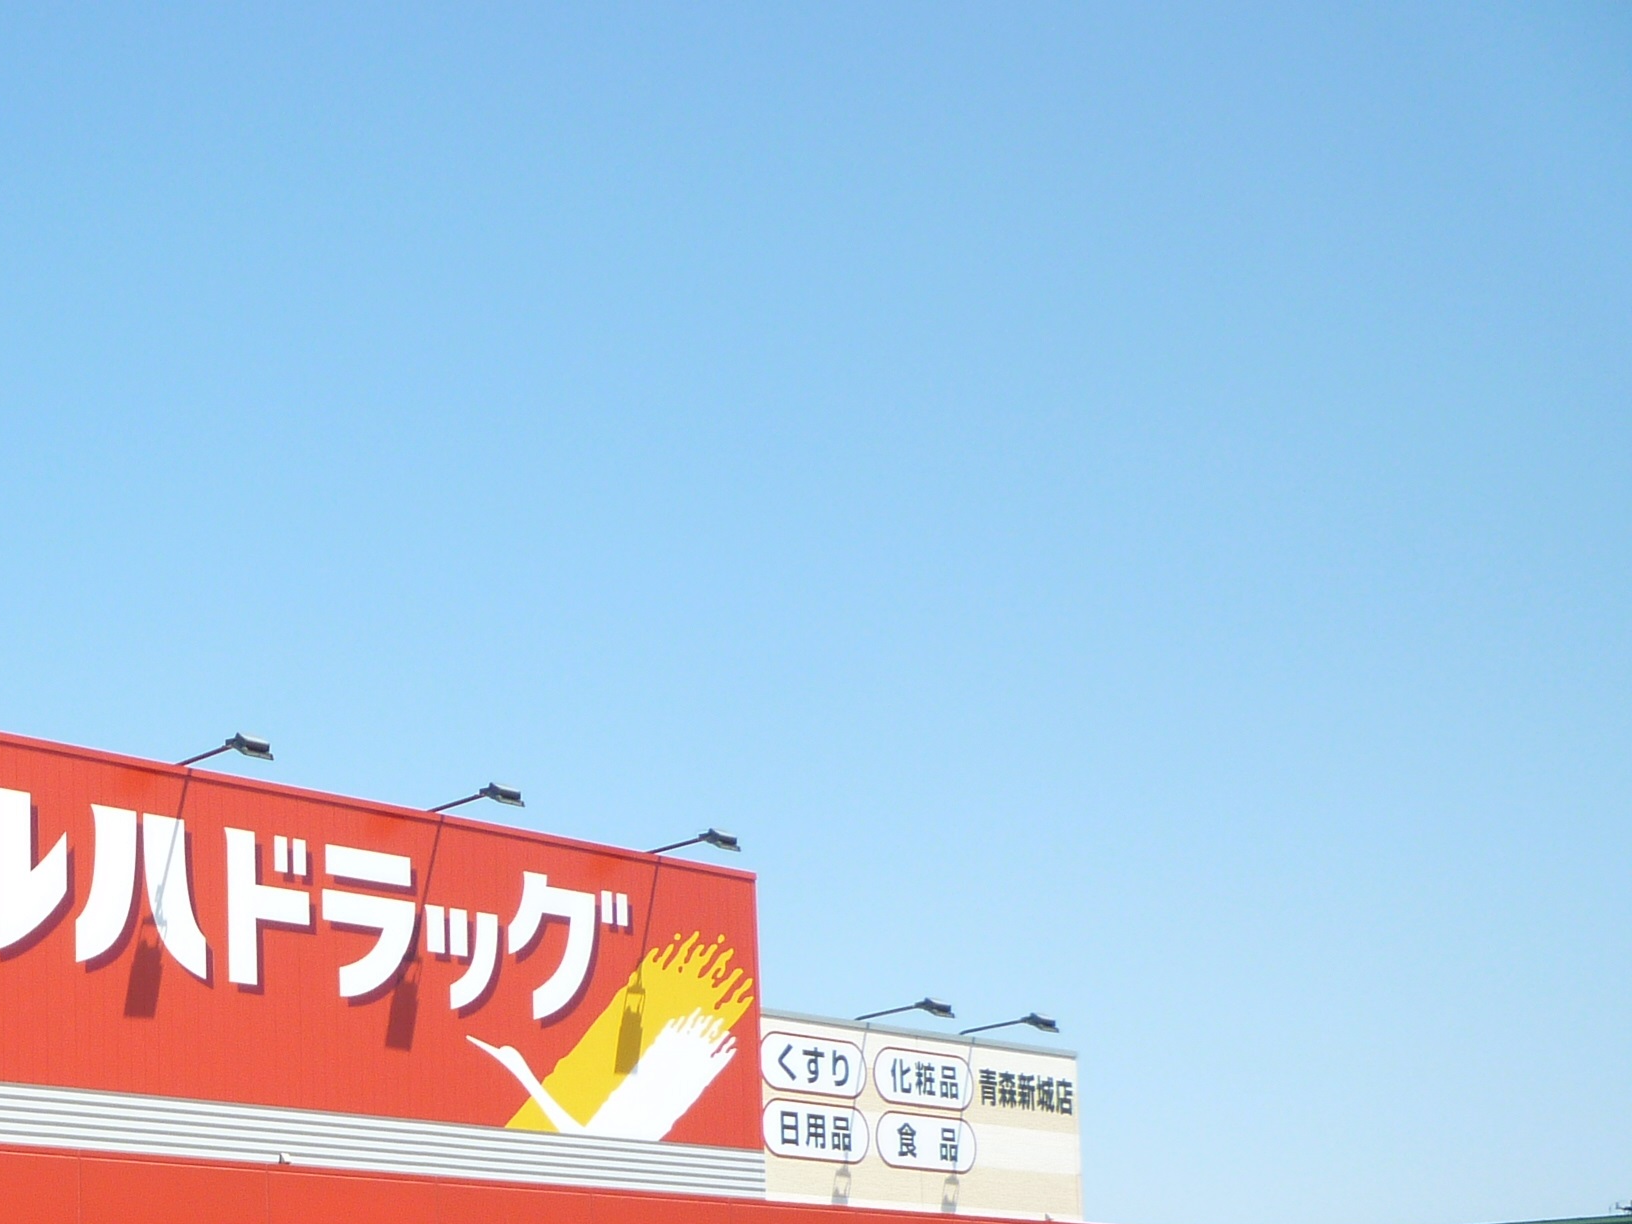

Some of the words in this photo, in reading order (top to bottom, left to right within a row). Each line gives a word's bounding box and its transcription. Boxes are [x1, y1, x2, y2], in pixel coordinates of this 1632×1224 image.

[777, 1043, 850, 1087] くすり
[890, 1058, 960, 1100] 化粧品
[979, 1068, 1074, 1117] 青森新城店
[780, 1110, 852, 1152] 日用品
[897, 1121, 958, 1162] 食品
